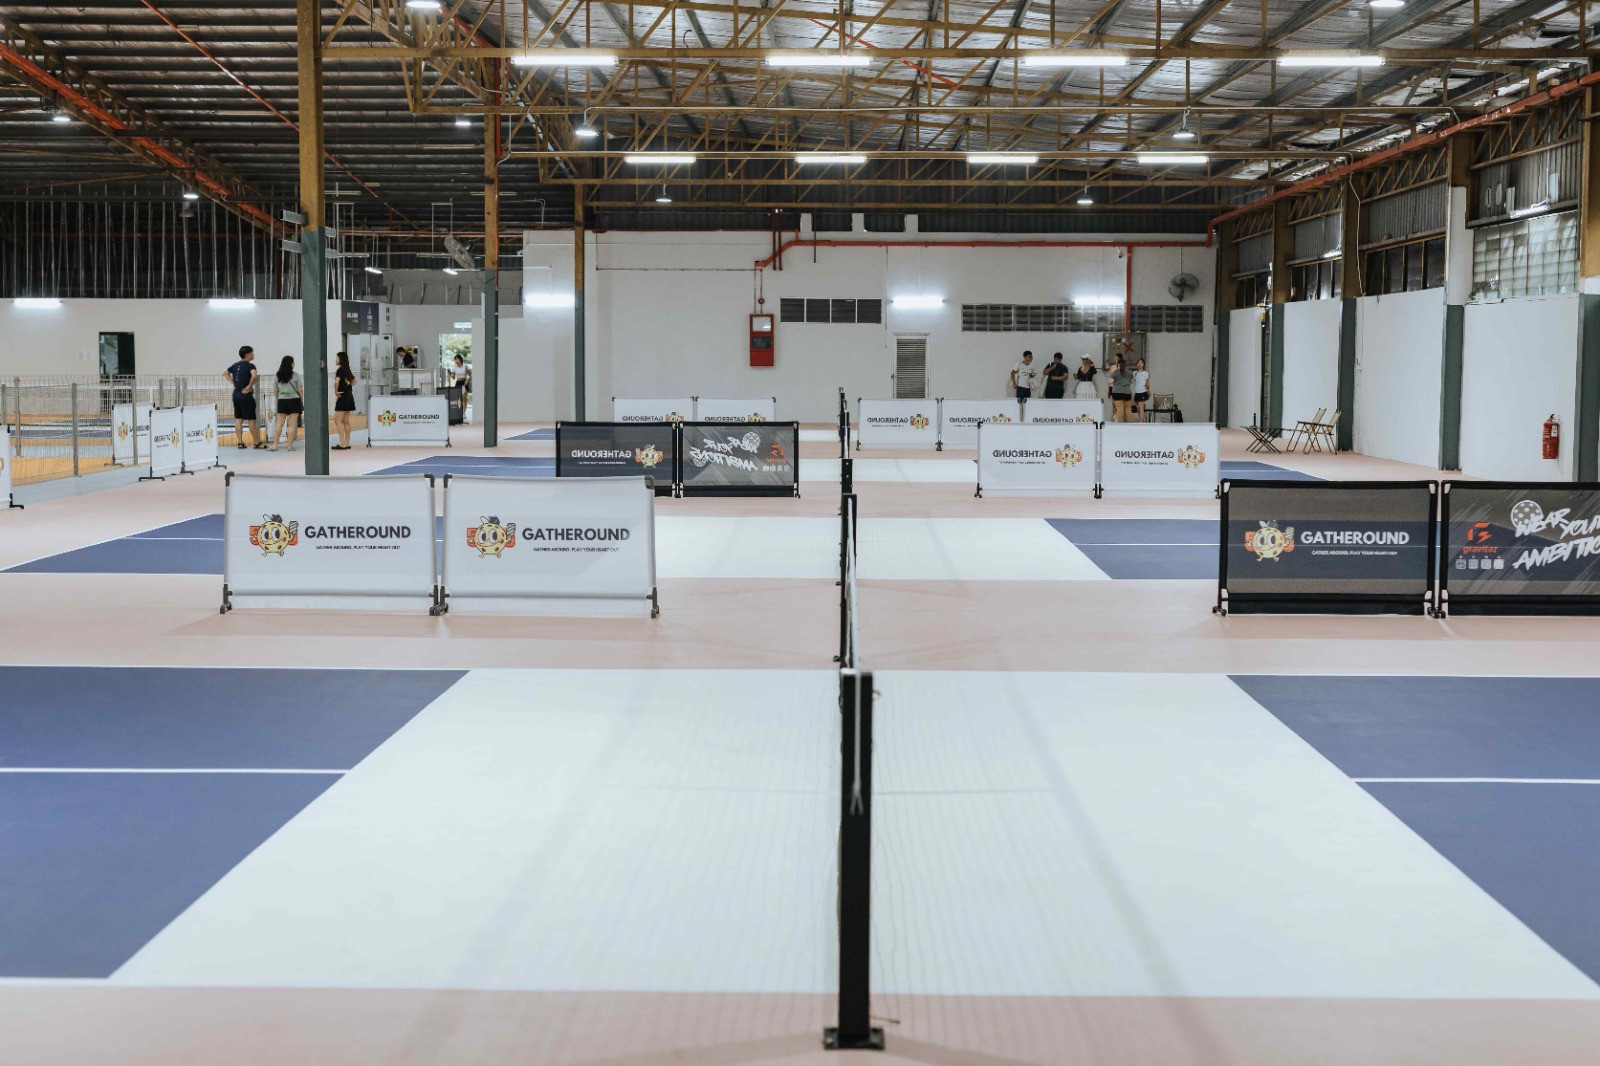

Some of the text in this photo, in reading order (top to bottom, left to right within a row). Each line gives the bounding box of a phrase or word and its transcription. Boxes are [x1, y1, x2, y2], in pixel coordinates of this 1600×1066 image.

[1515, 508, 1571, 538] WEAR
[304, 525, 411, 539] GATHEROUND
[522, 527, 630, 541] GATHEROUND
[1300, 531, 1410, 545] GATHEROUND
[1462, 545, 1498, 555] gravitaz
